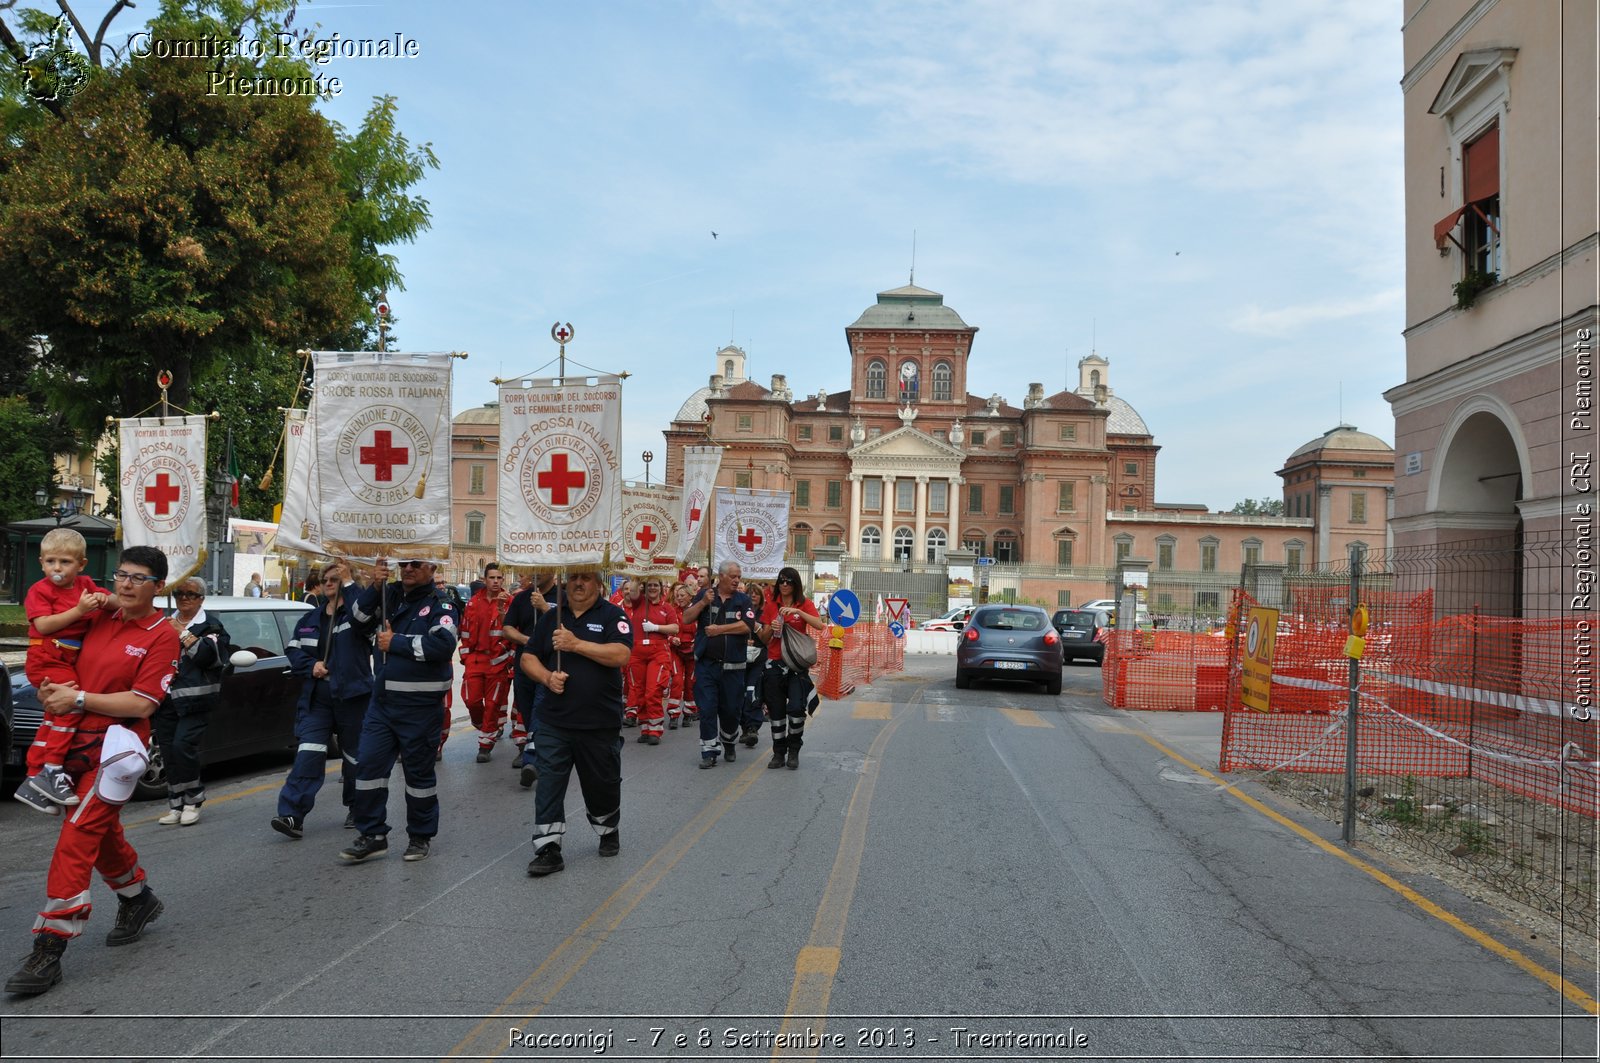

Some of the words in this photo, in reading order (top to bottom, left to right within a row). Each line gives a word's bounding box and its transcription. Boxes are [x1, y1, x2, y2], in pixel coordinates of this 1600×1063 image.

[327, 372, 349, 382] CORPO
[352, 373, 386, 382] VOLONTARI
[389, 373, 401, 382] DEL
[402, 373, 438, 383] SOCCORSO
[322, 386, 356, 398] CROCE
[359, 386, 394, 398] ROSSA
[398, 386, 444, 399] ITALIANA
[504, 393, 525, 404] CORPI
[527, 393, 564, 404] VOLONTARI
[567, 392, 581, 402] DEL
[584, 392, 617, 402] SOCCORSO
[528, 404, 566, 415] FEMMINILE
[568, 404, 572, 414] E
[574, 404, 604, 414] PIONIERI
[339, 408, 388, 456] CONVENZIONE
[390, 410, 402, 423] DI
[402, 417, 430, 458] GINEVRA
[140, 442, 174, 458] ROSSA
[503, 431, 530, 473] CROCE
[530, 416, 575, 434] ROSSA
[577, 420, 619, 472] ITALIANA
[533, 444, 543, 457] DI
[544, 436, 587, 454] GINEVRA
[585, 453, 598, 466] 22
[522, 458, 552, 521] CONVENZIONE
[588, 468, 601, 505] AGOSTO
[570, 502, 592, 520] 1864
[332, 512, 383, 525] COMITATO
[386, 512, 426, 526] LOCALE
[429, 512, 440, 525] DI
[357, 528, 417, 540] MONESIGLIO
[509, 531, 558, 541] COMITATO
[561, 530, 600, 541] LOCALE
[603, 530, 613, 540] DI
[503, 543, 542, 554] BORGO
[558, 542, 620, 554] DALMAZO
